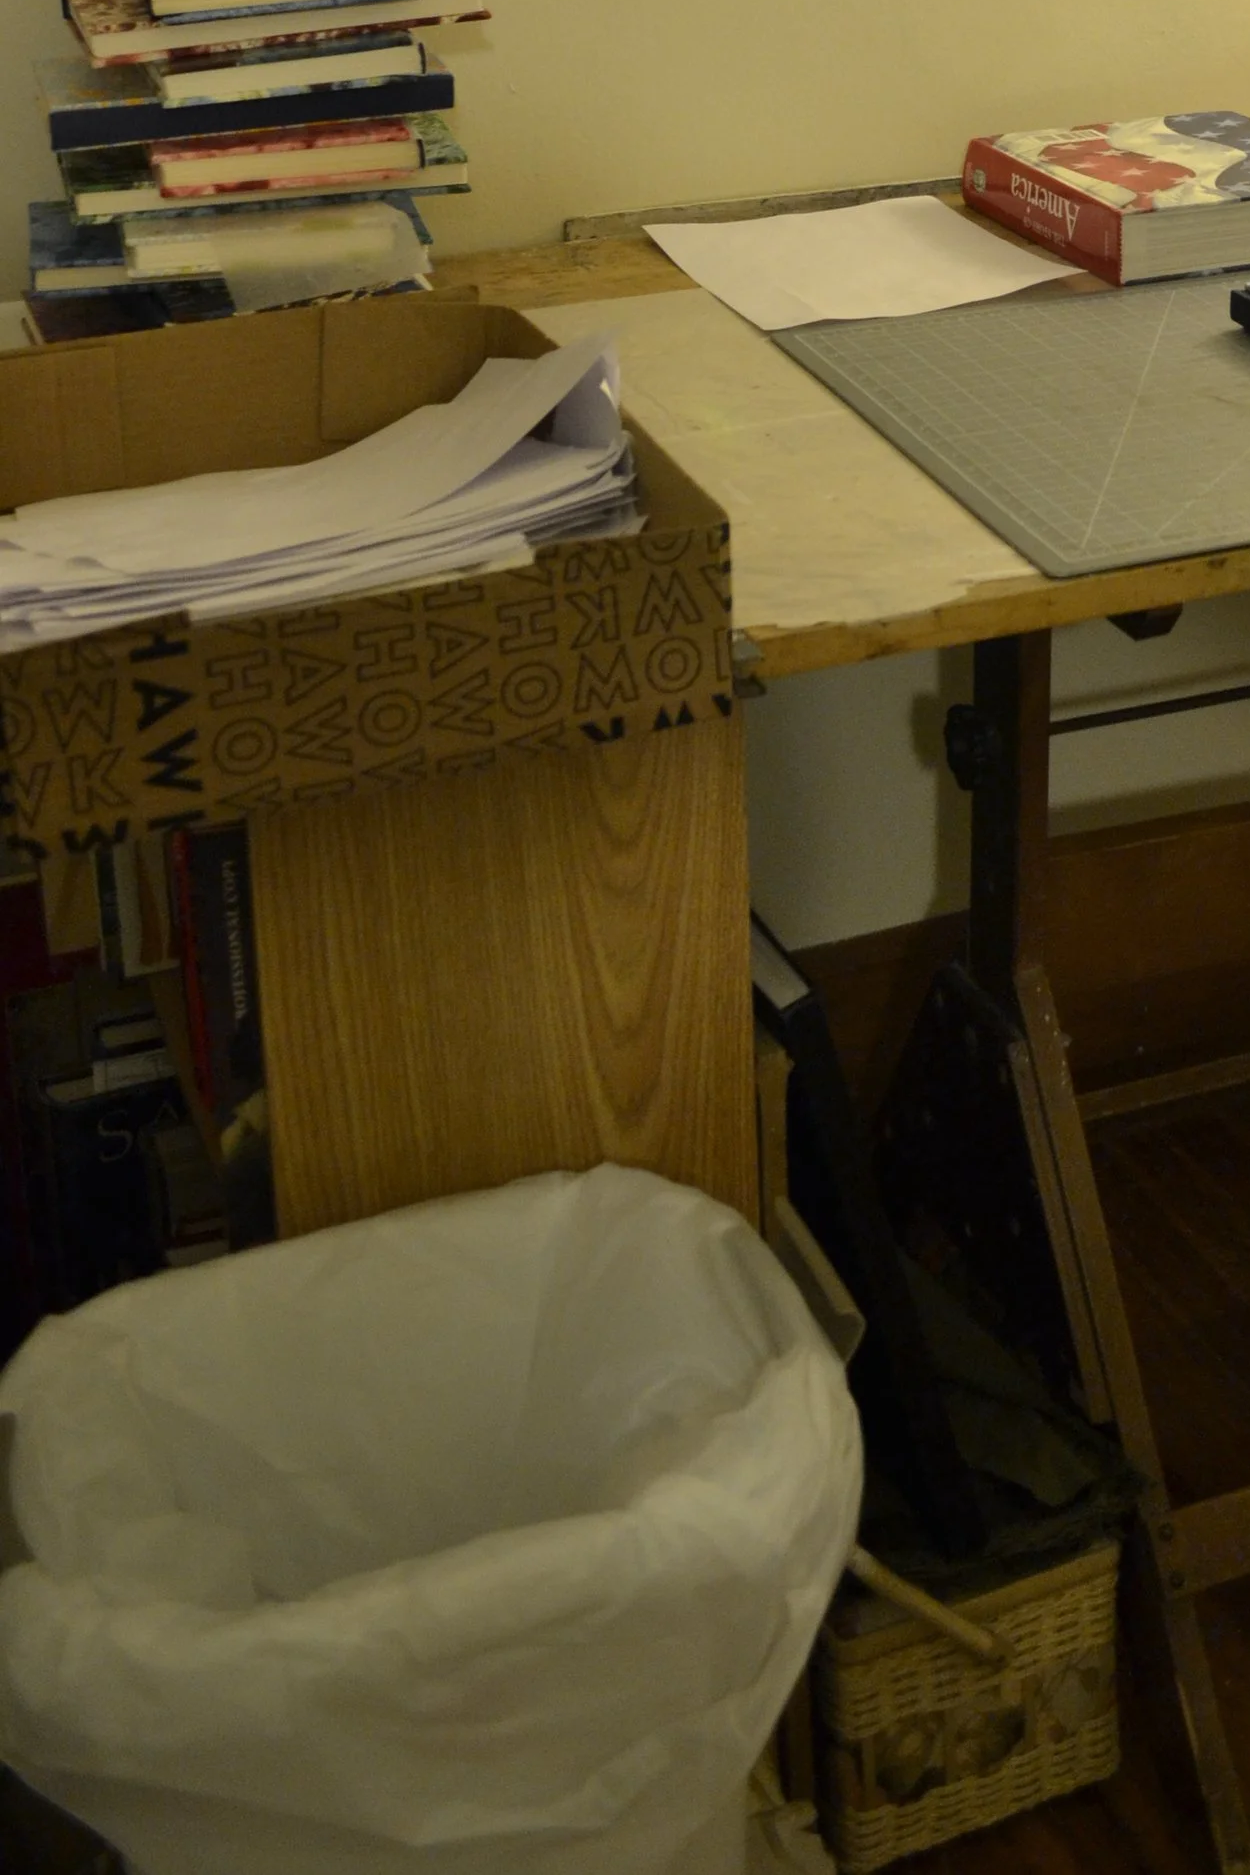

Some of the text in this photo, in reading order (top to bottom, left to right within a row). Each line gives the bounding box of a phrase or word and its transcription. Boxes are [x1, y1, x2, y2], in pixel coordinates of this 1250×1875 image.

[1010, 173, 1081, 242] America
[220, 859, 250, 1023] ROFESSIONAL COPY
